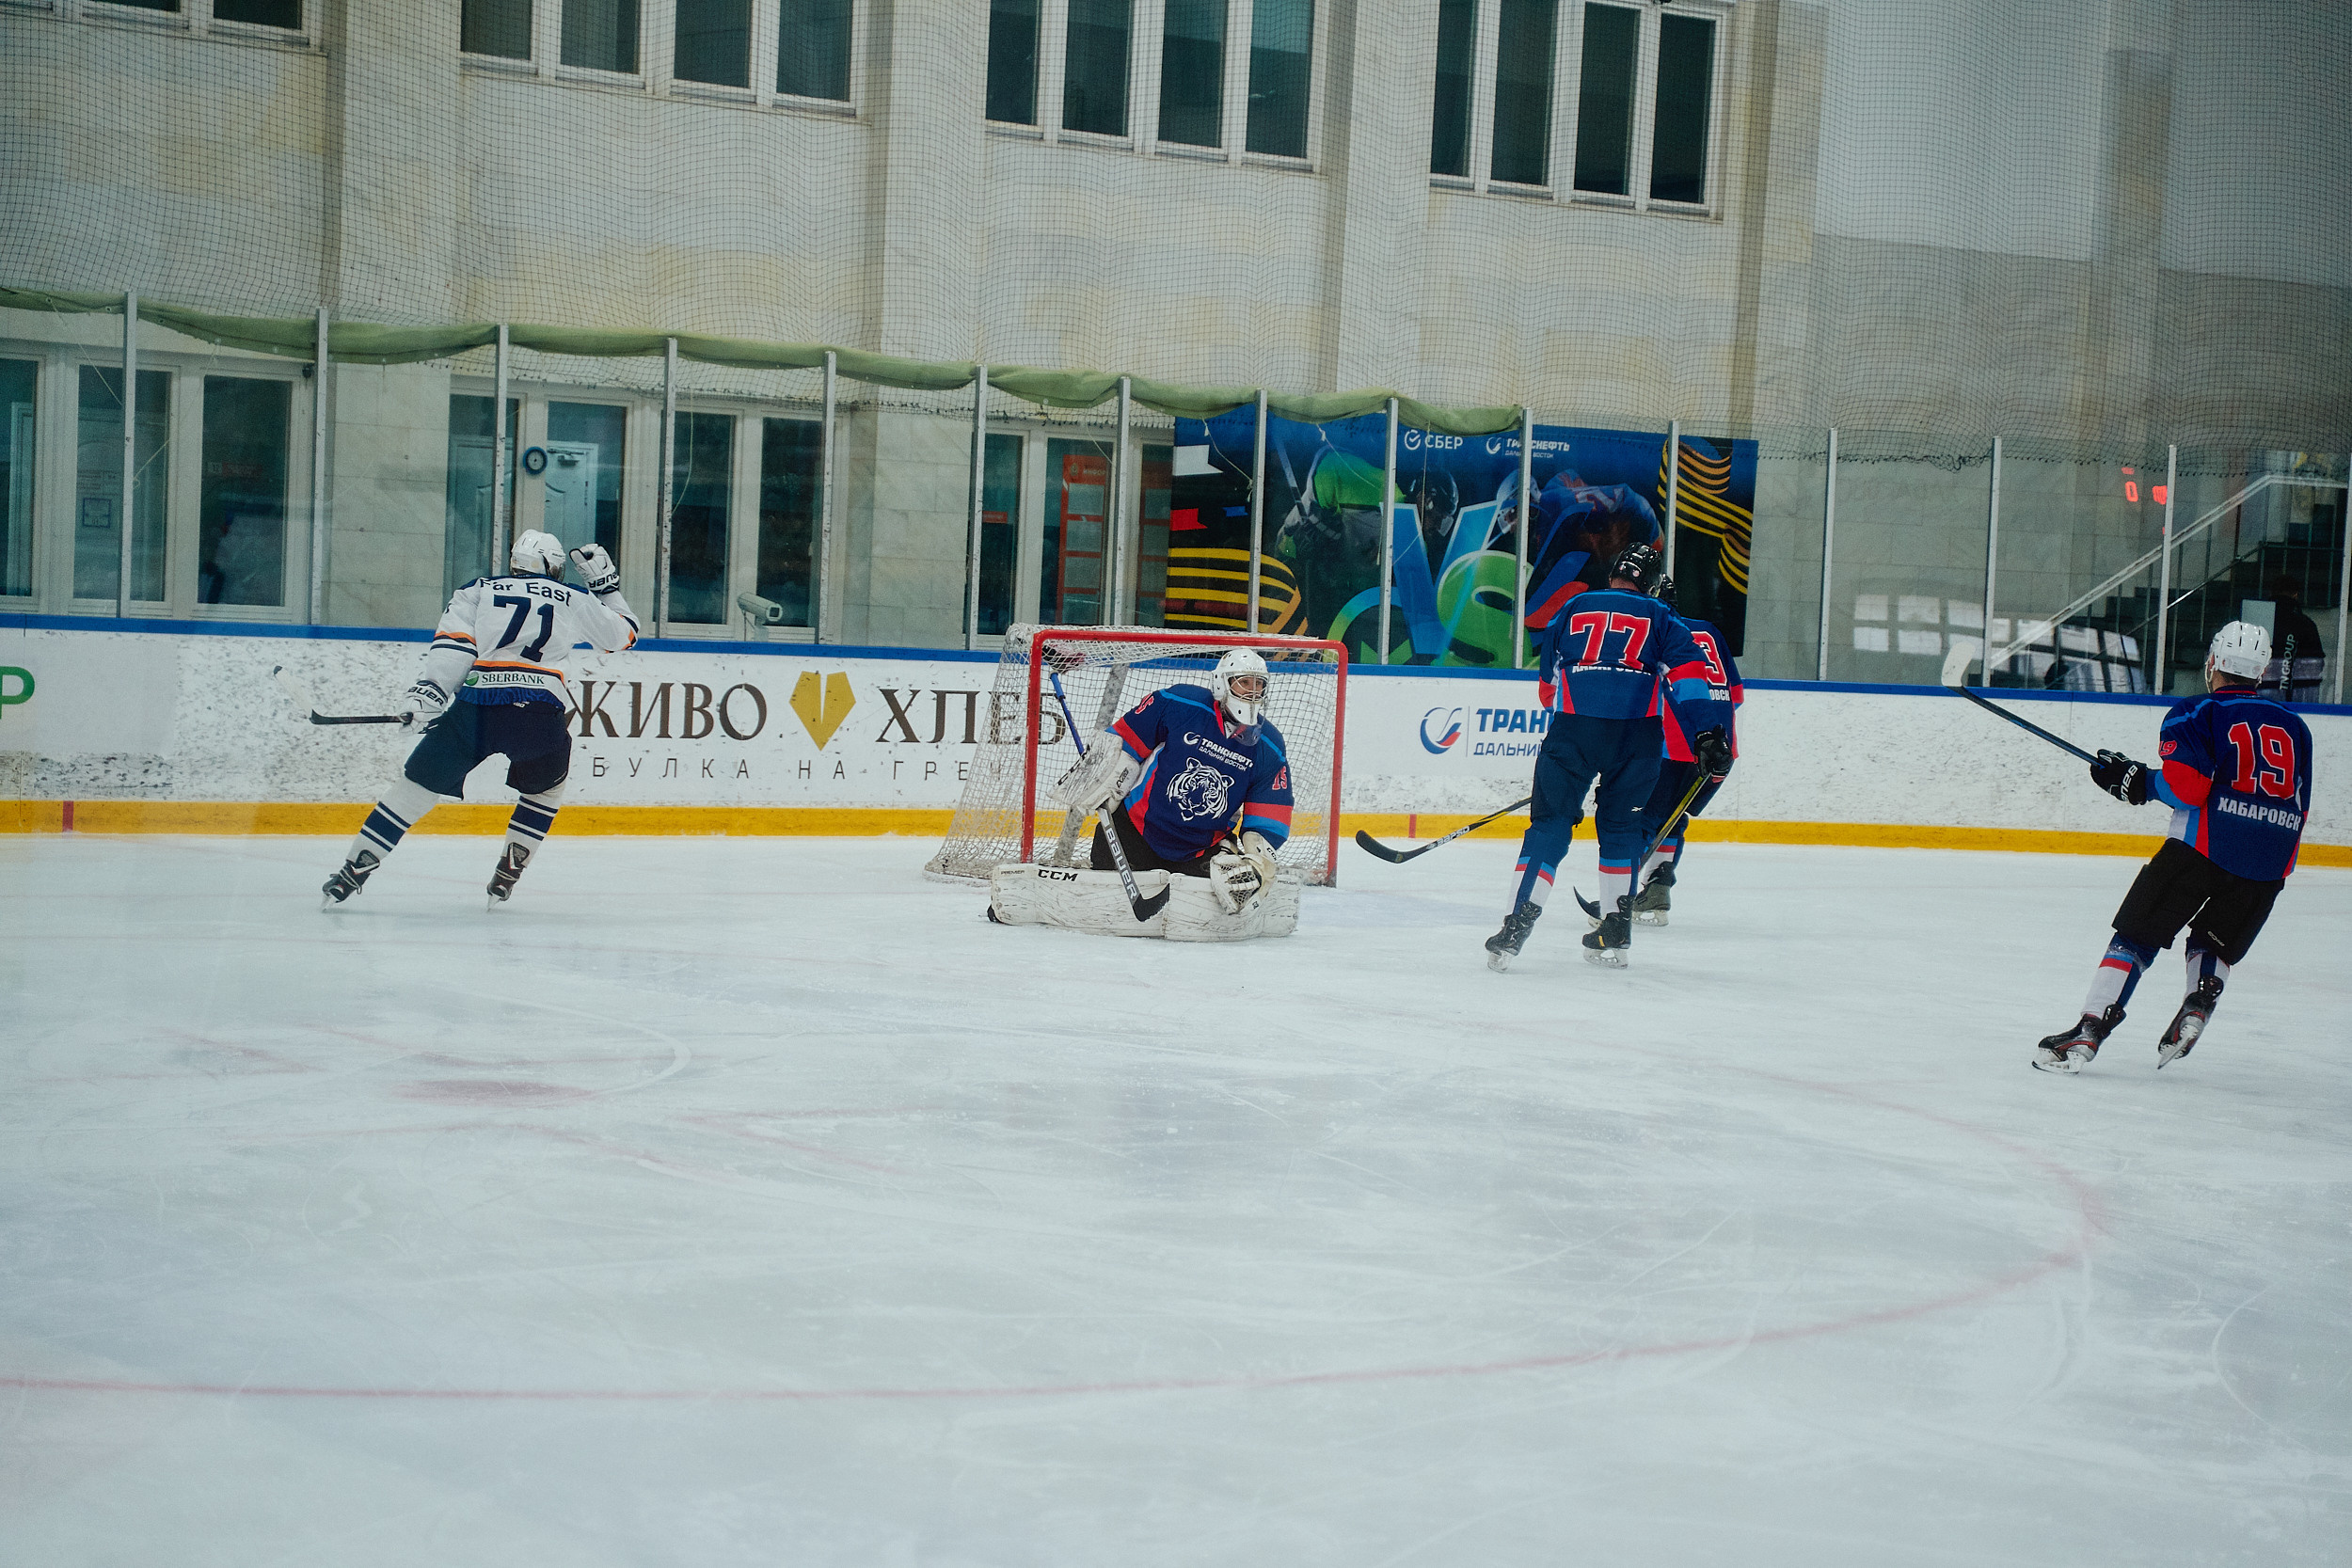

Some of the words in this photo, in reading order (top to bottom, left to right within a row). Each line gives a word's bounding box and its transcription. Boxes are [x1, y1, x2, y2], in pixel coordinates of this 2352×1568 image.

[1424, 435, 1464, 450] СБЕР
[1506, 438, 1570, 451] ТРСНЕФТЬ
[588, 572, 617, 588] AUER
[480, 578, 514, 591] Far
[526, 582, 572, 607] East
[494, 594, 554, 662] 71
[1570, 611, 1651, 671] 77
[482, 673, 545, 685] SBERBANK
[407, 687, 444, 706] AUER
[1708, 689, 1731, 702] ОВСК
[564, 680, 767, 741] ЖИВО
[875, 688, 1066, 744] ХЛЕБ
[2158, 740, 2177, 757] 19
[593, 756, 749, 779] БУЛКА
[799, 759, 845, 780] НА
[1224, 758, 1248, 771] ВОСТОК
[2228, 721, 2295, 800] 19
[1272, 766, 1287, 790] 15
[2217, 797, 2302, 832] ХАБАРОВСК
[1105, 827, 1137, 898] BAUER
[1038, 868, 1078, 882] CCM
